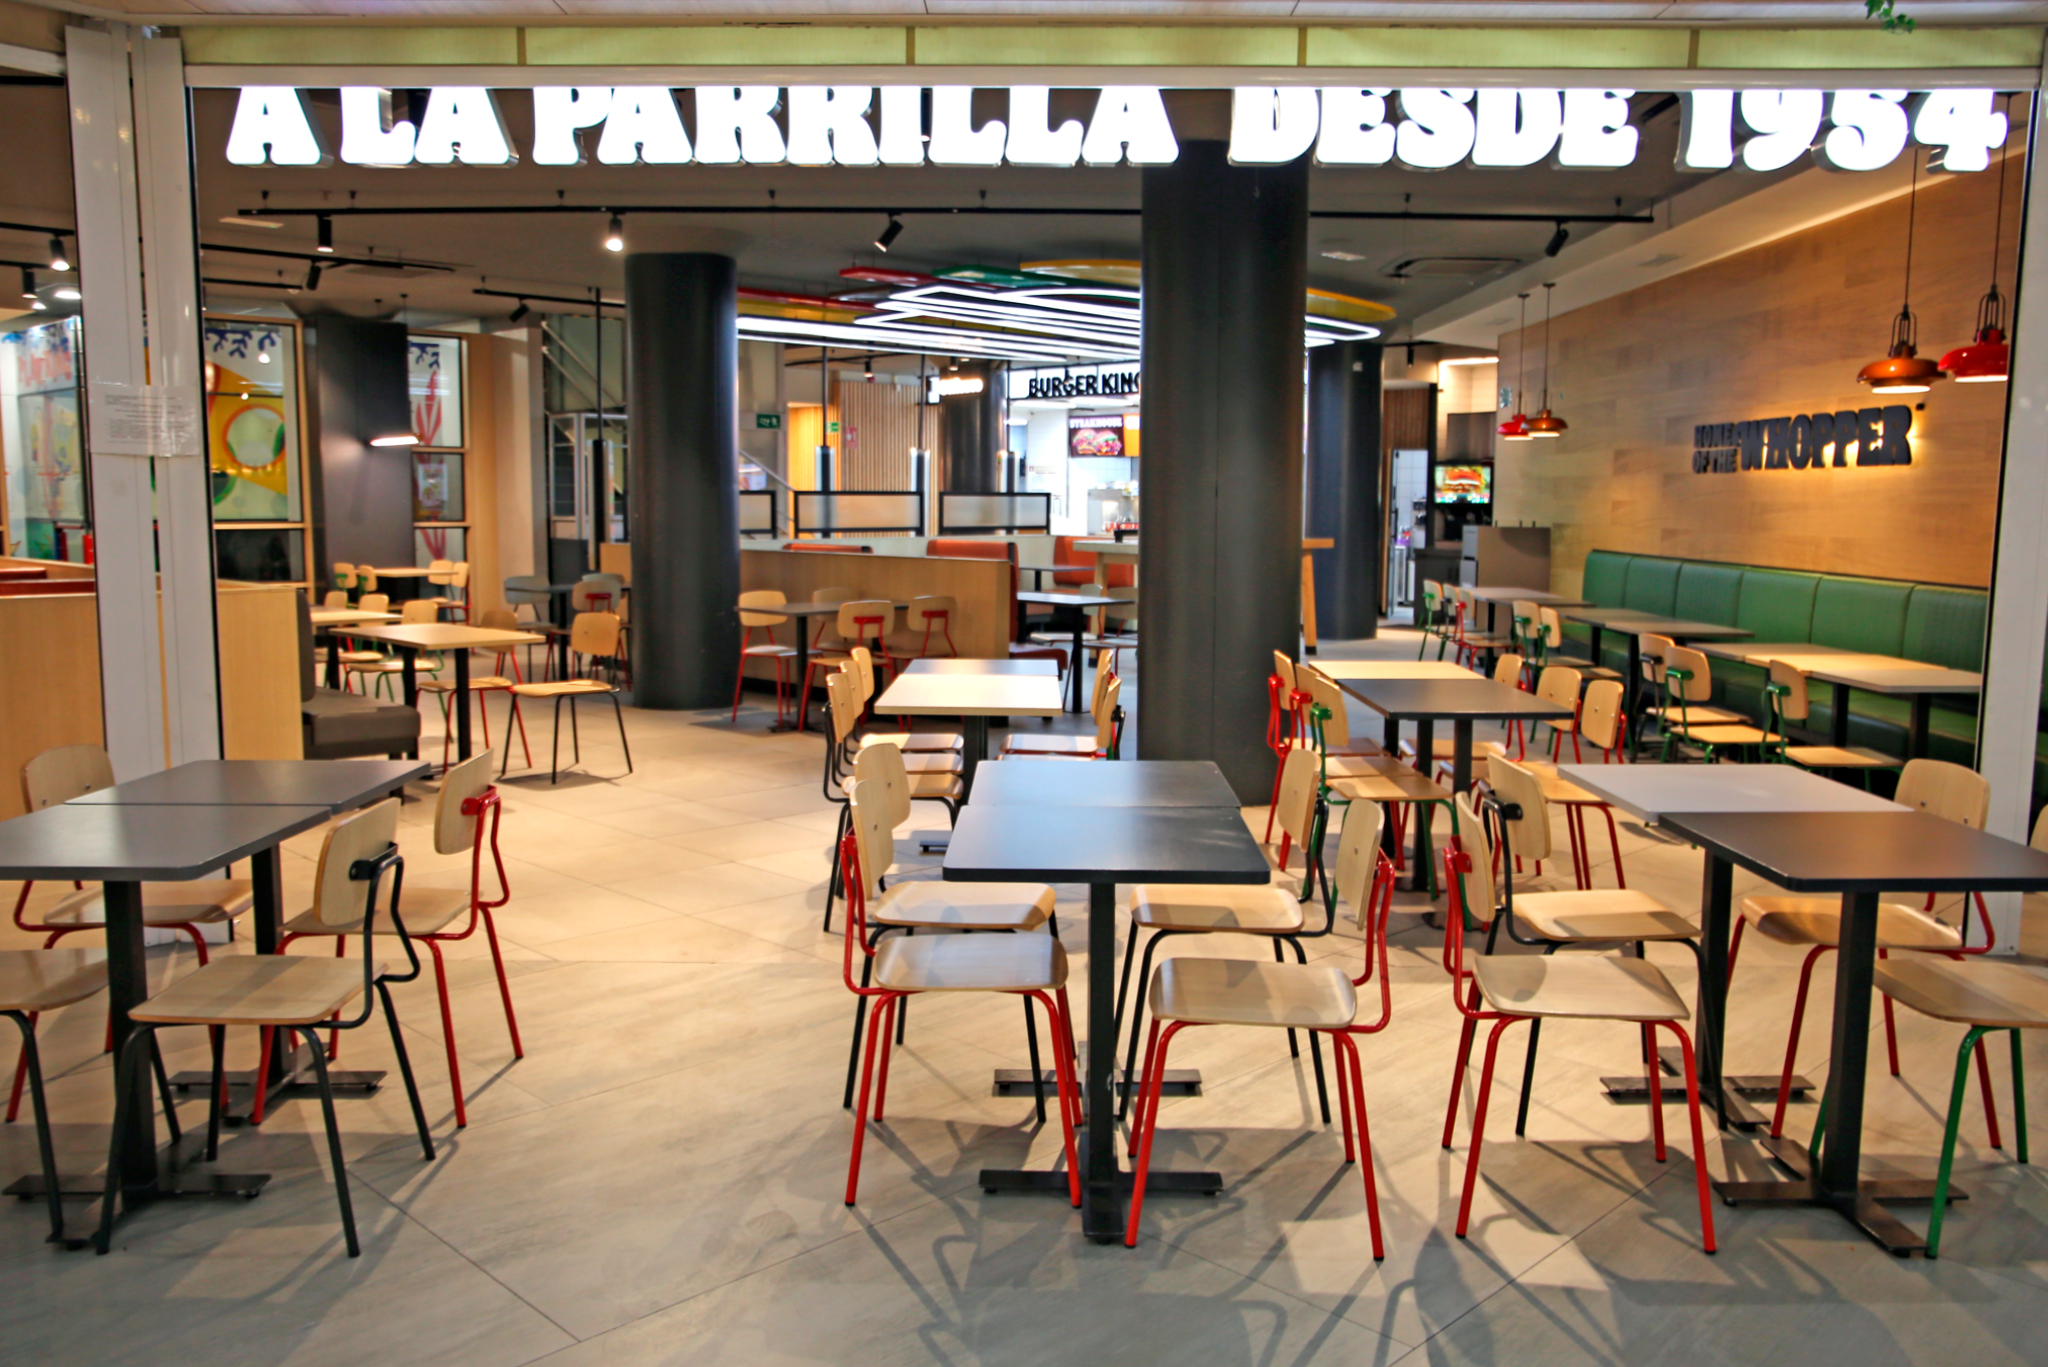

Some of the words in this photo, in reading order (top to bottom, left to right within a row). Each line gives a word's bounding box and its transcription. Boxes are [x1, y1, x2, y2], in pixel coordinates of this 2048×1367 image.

[226, 86, 322, 166] A
[340, 86, 512, 166] LA
[532, 86, 1180, 166] PARRILLA
[1229, 87, 1640, 169] DESDE
[1686, 89, 2009, 172] 1954
[1029, 371, 1098, 398] BURGER
[1069, 416, 1123, 429] STEAKHOUSE
[1694, 422, 1735, 448] HOME
[1735, 405, 1912, 471] WHOPPER
[1692, 450, 1709, 474] OF
[1711, 448, 1738, 473] THE
